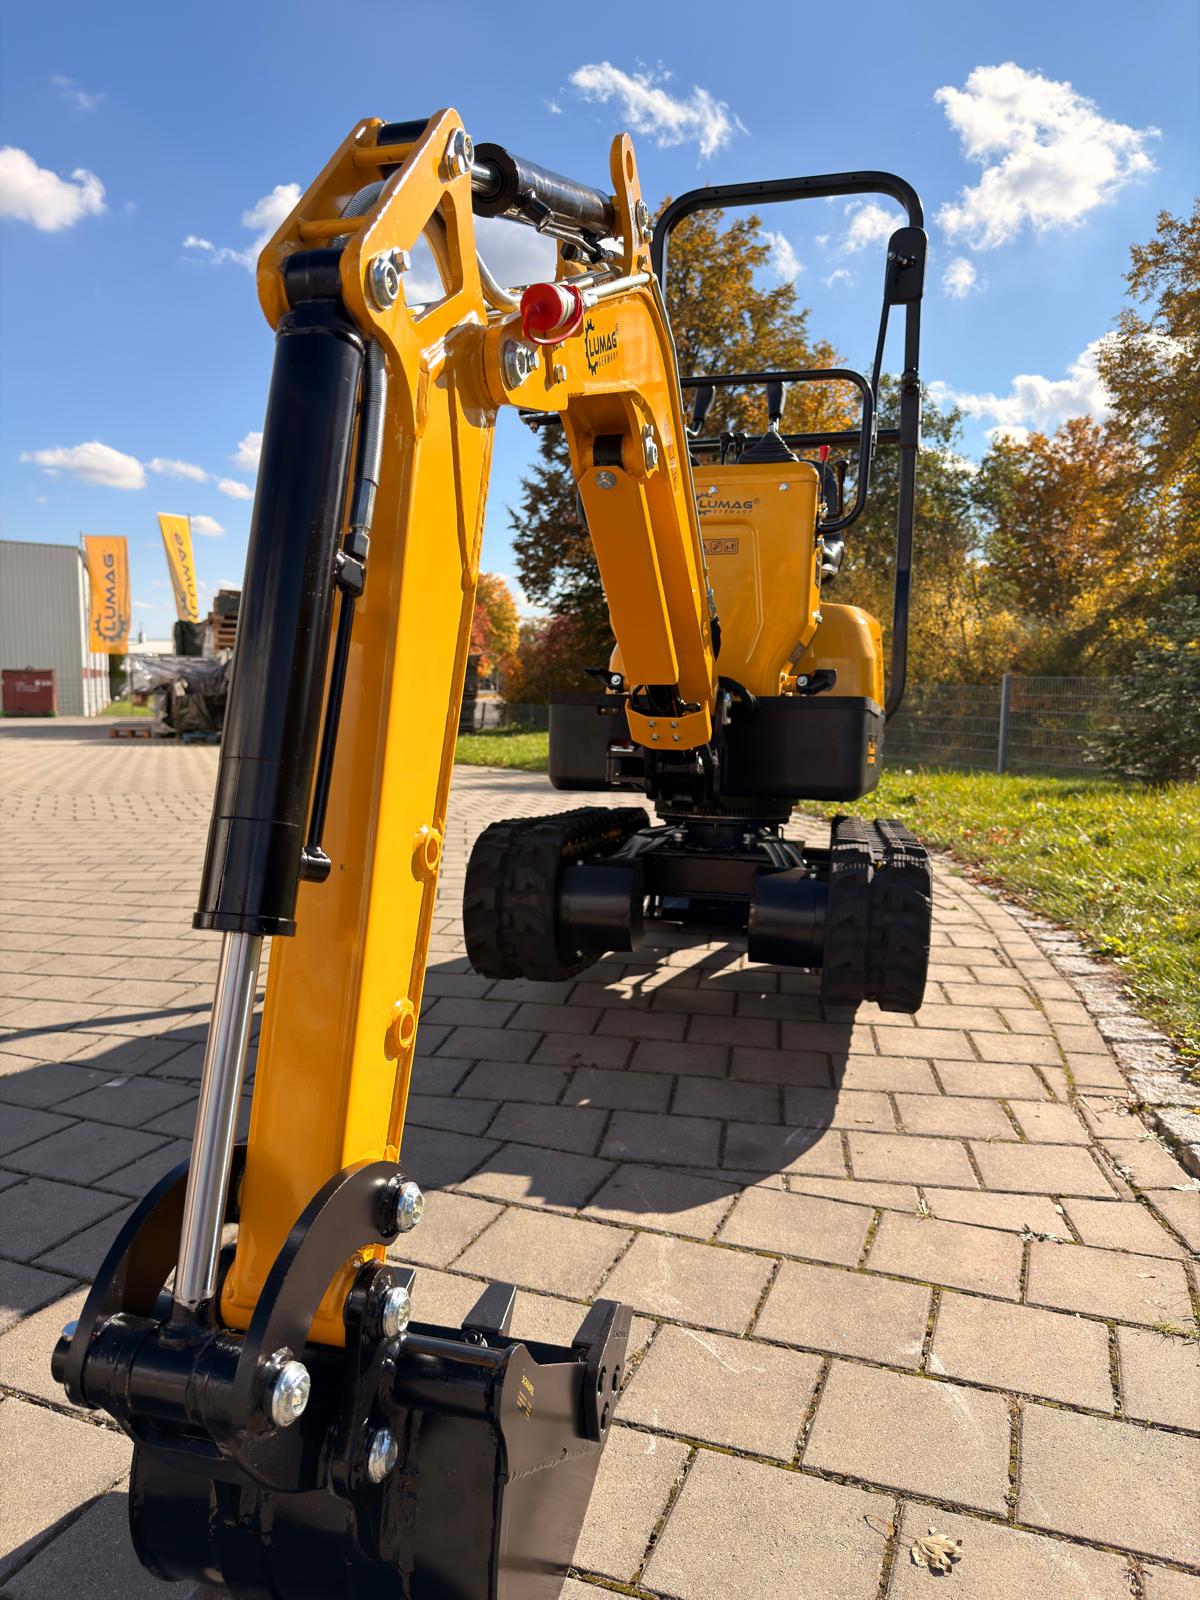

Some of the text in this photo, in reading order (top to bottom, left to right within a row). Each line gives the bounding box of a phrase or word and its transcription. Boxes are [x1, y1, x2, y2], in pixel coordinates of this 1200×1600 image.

[589, 332, 617, 358] LUMAG
[699, 500, 753, 509] LUMAG
[102, 554, 117, 631] LUMAG
